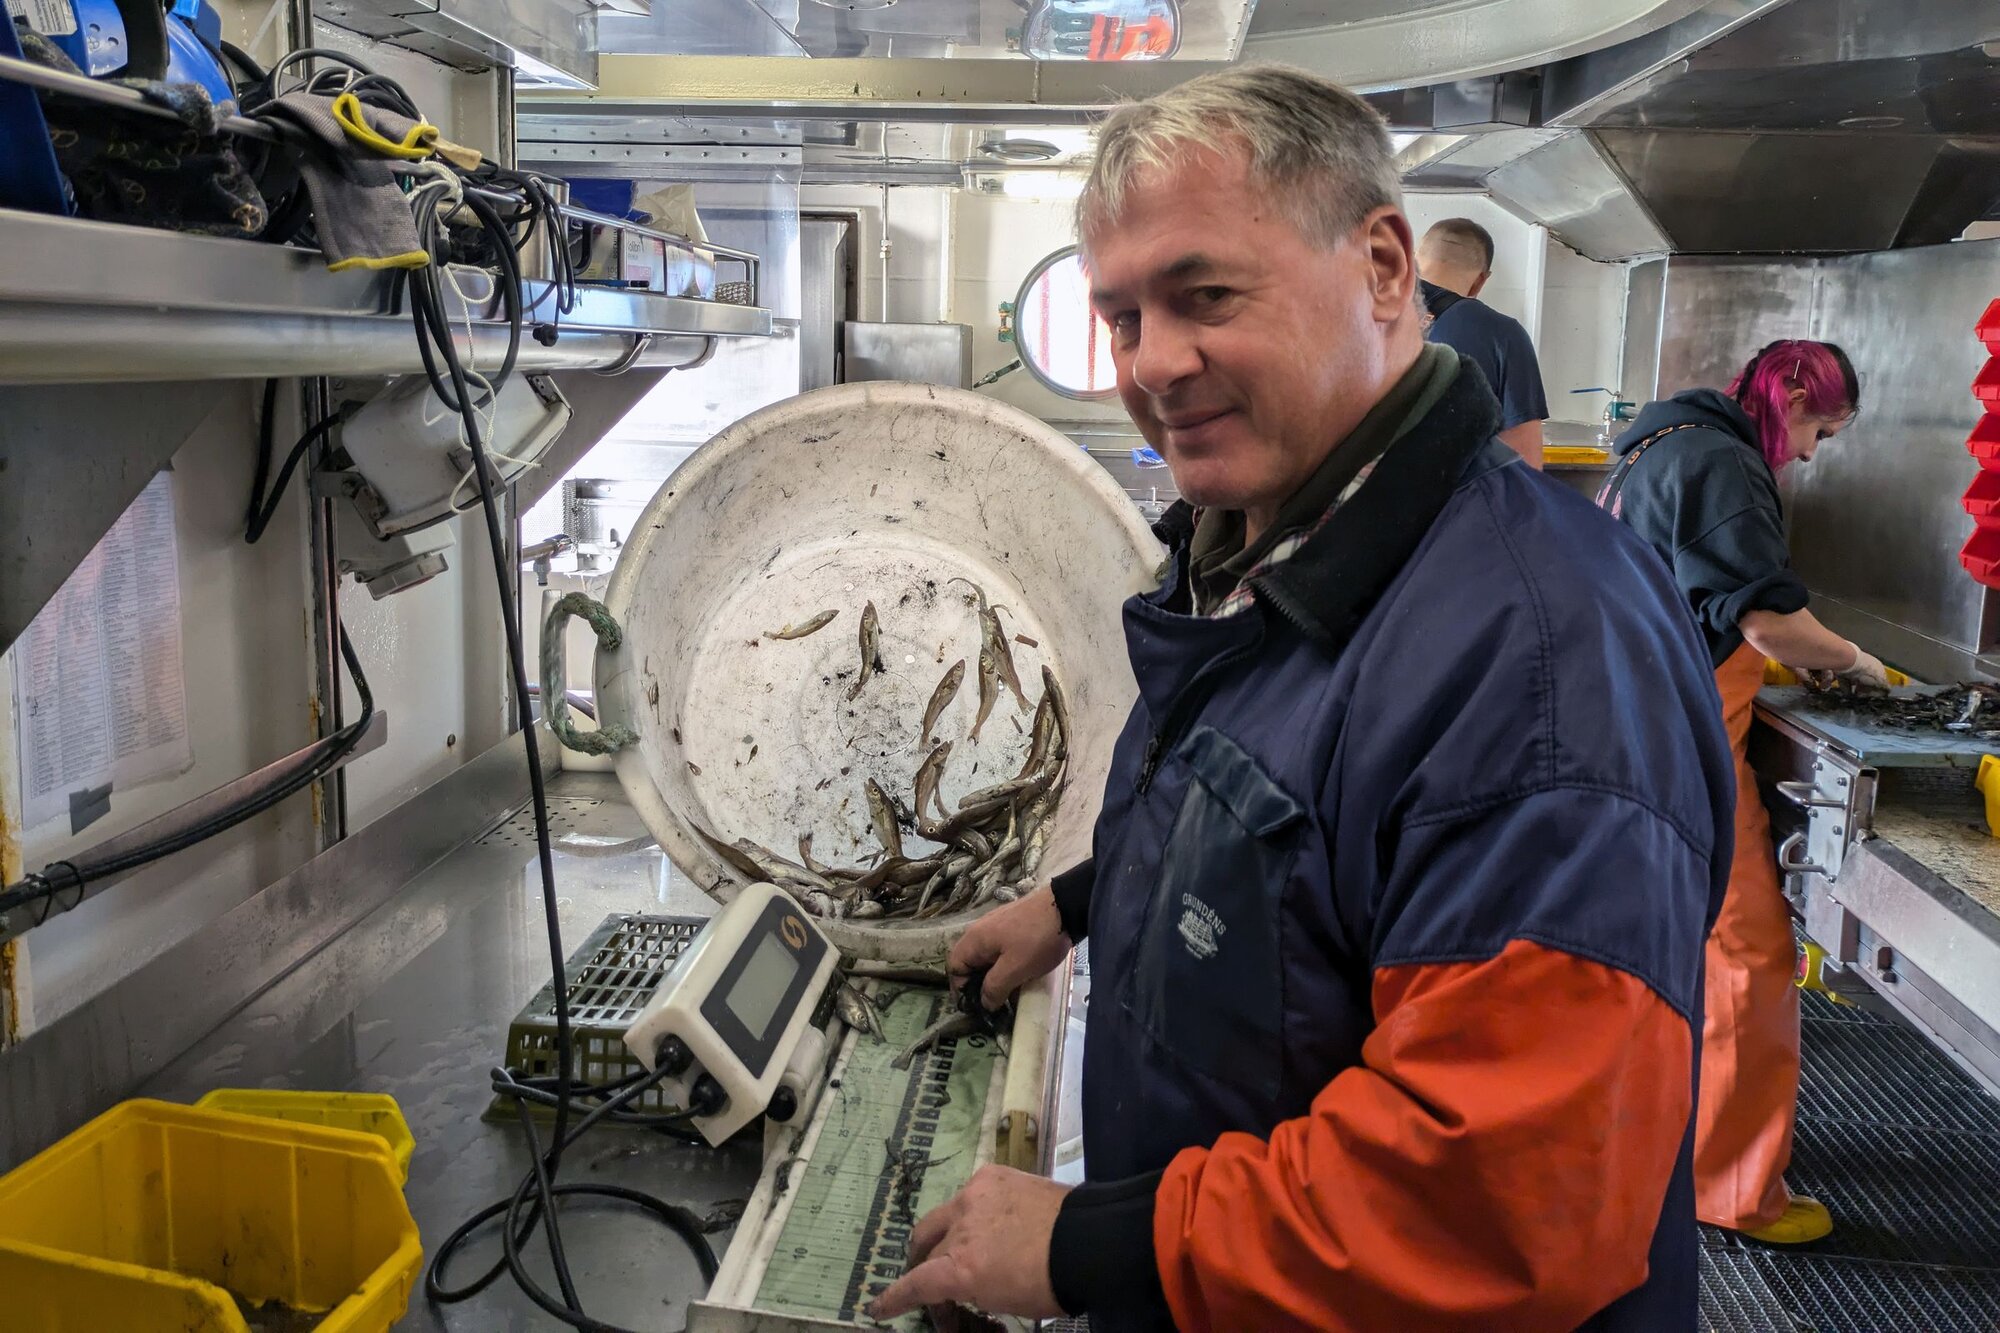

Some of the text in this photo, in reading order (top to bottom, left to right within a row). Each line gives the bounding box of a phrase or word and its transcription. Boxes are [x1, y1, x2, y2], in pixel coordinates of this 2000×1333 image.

[1182, 892, 1227, 936] GRUNDÉNS
[824, 1164, 838, 1176] 20
[810, 1204, 822, 1214] 15
[792, 1246, 808, 1260] 10
